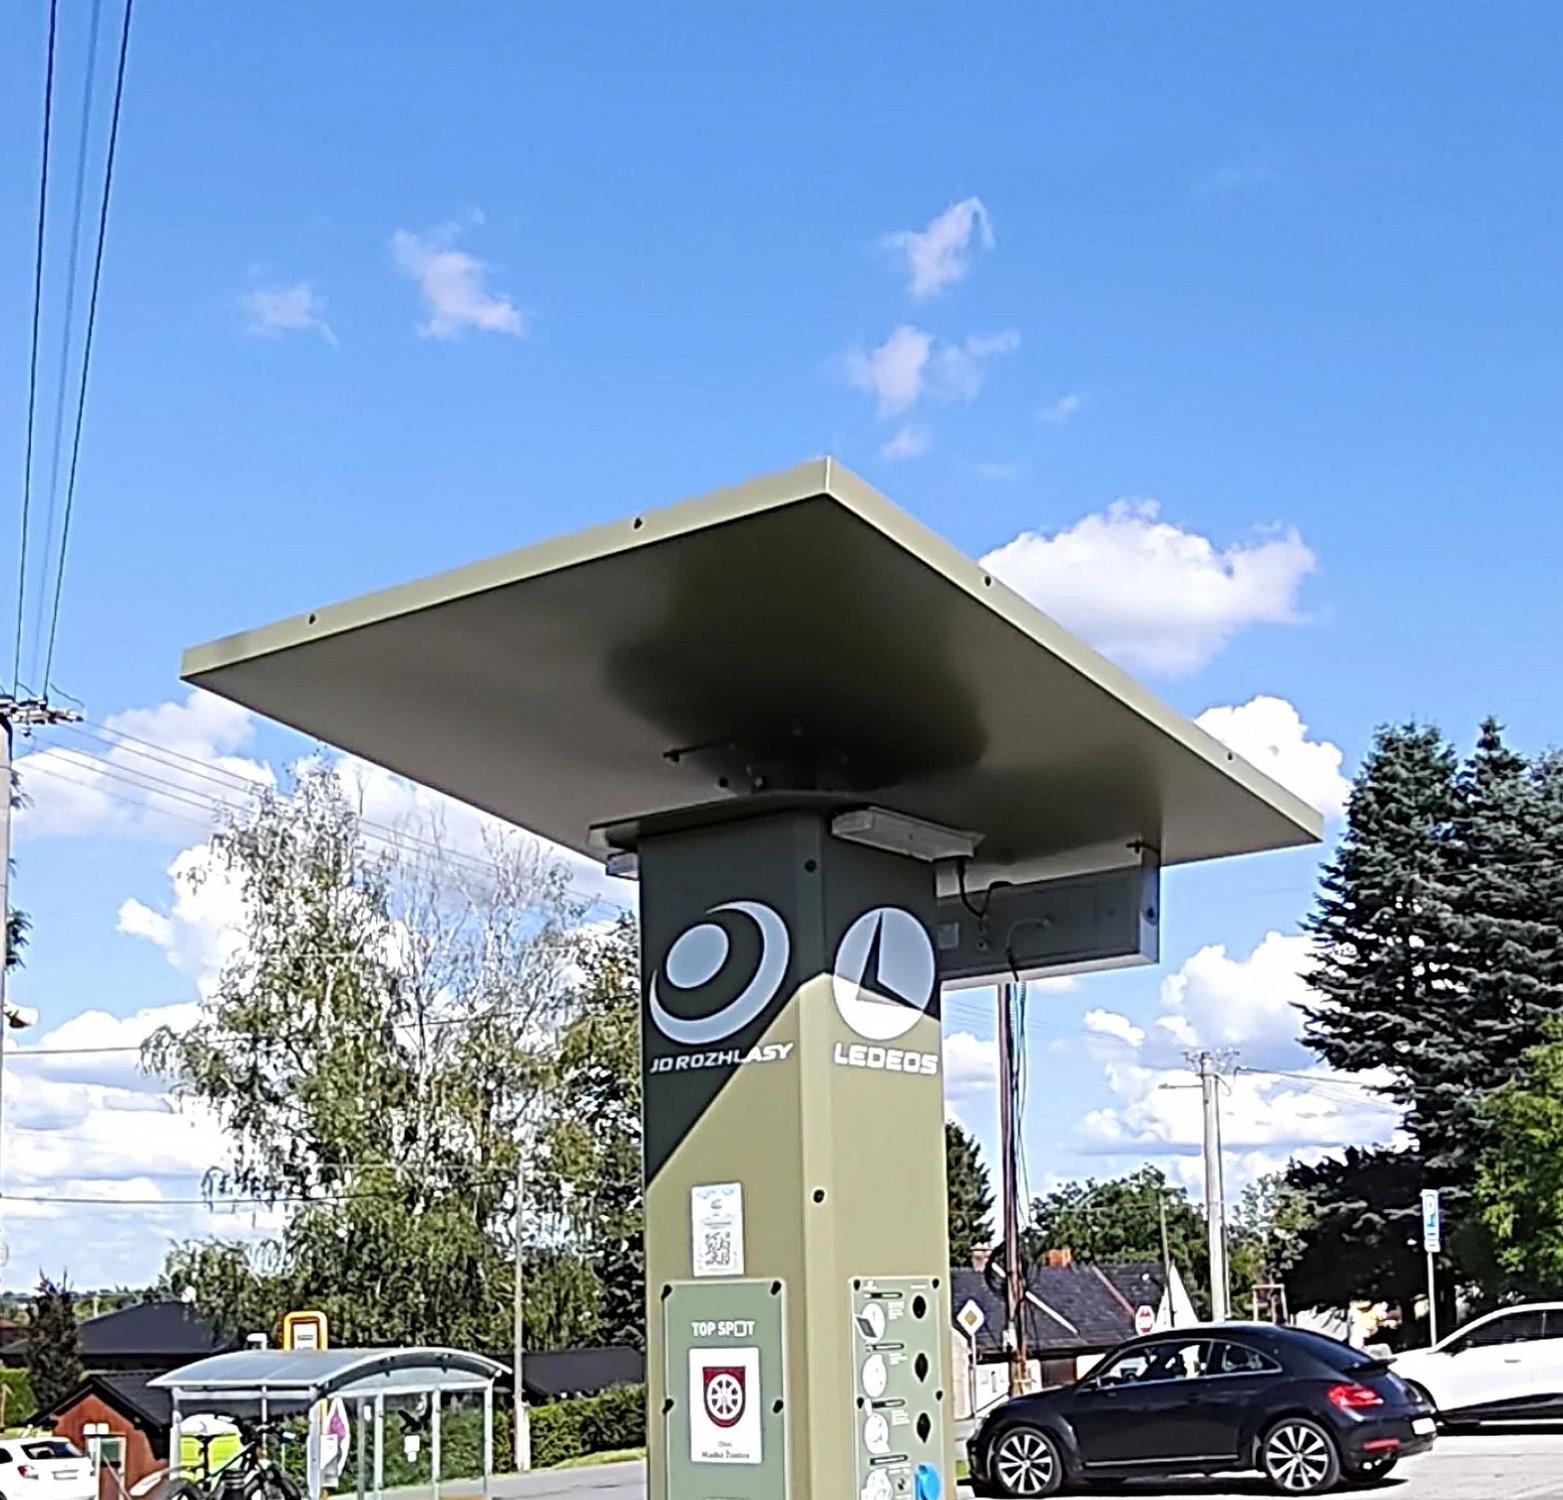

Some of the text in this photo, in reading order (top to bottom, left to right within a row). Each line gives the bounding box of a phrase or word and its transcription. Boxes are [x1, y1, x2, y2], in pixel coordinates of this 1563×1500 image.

[675, 1042, 794, 1071] ROZHLASY
[834, 1042, 938, 1075] LEDEOS
[691, 1321, 716, 1337] TOP
